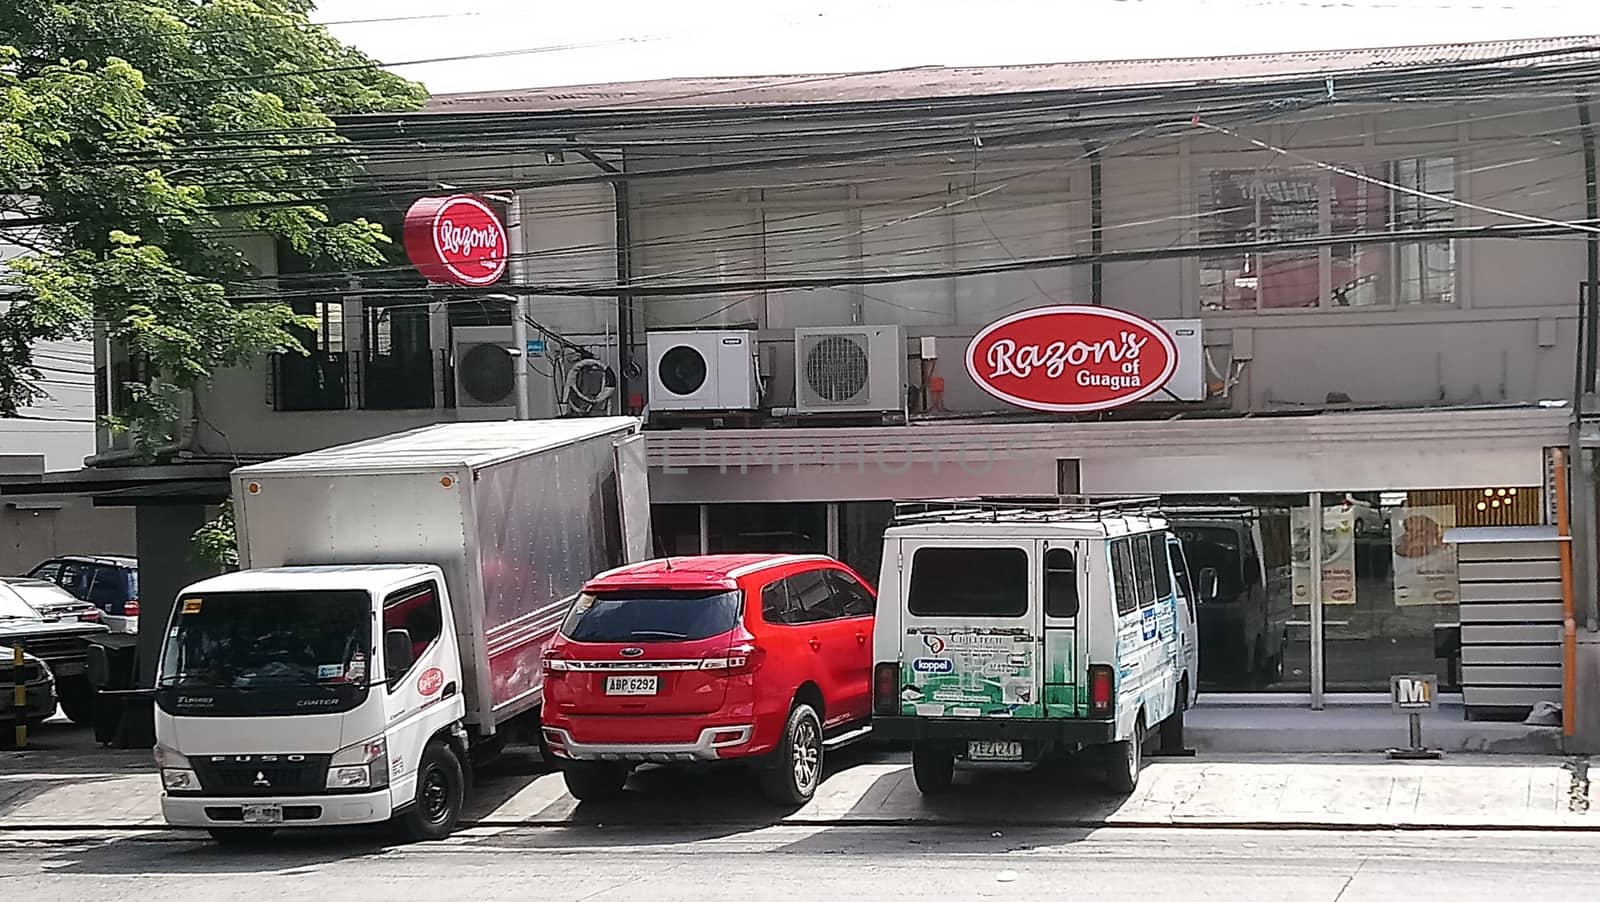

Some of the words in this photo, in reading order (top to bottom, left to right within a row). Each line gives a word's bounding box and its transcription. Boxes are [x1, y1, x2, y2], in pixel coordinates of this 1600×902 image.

[987, 331, 1148, 379] Razon's
[1121, 359, 1140, 375] of
[1076, 370, 1141, 391] Guagua
[918, 659, 948, 673] koppel
[609, 679, 628, 691] ABP
[630, 678, 655, 691] 6292
